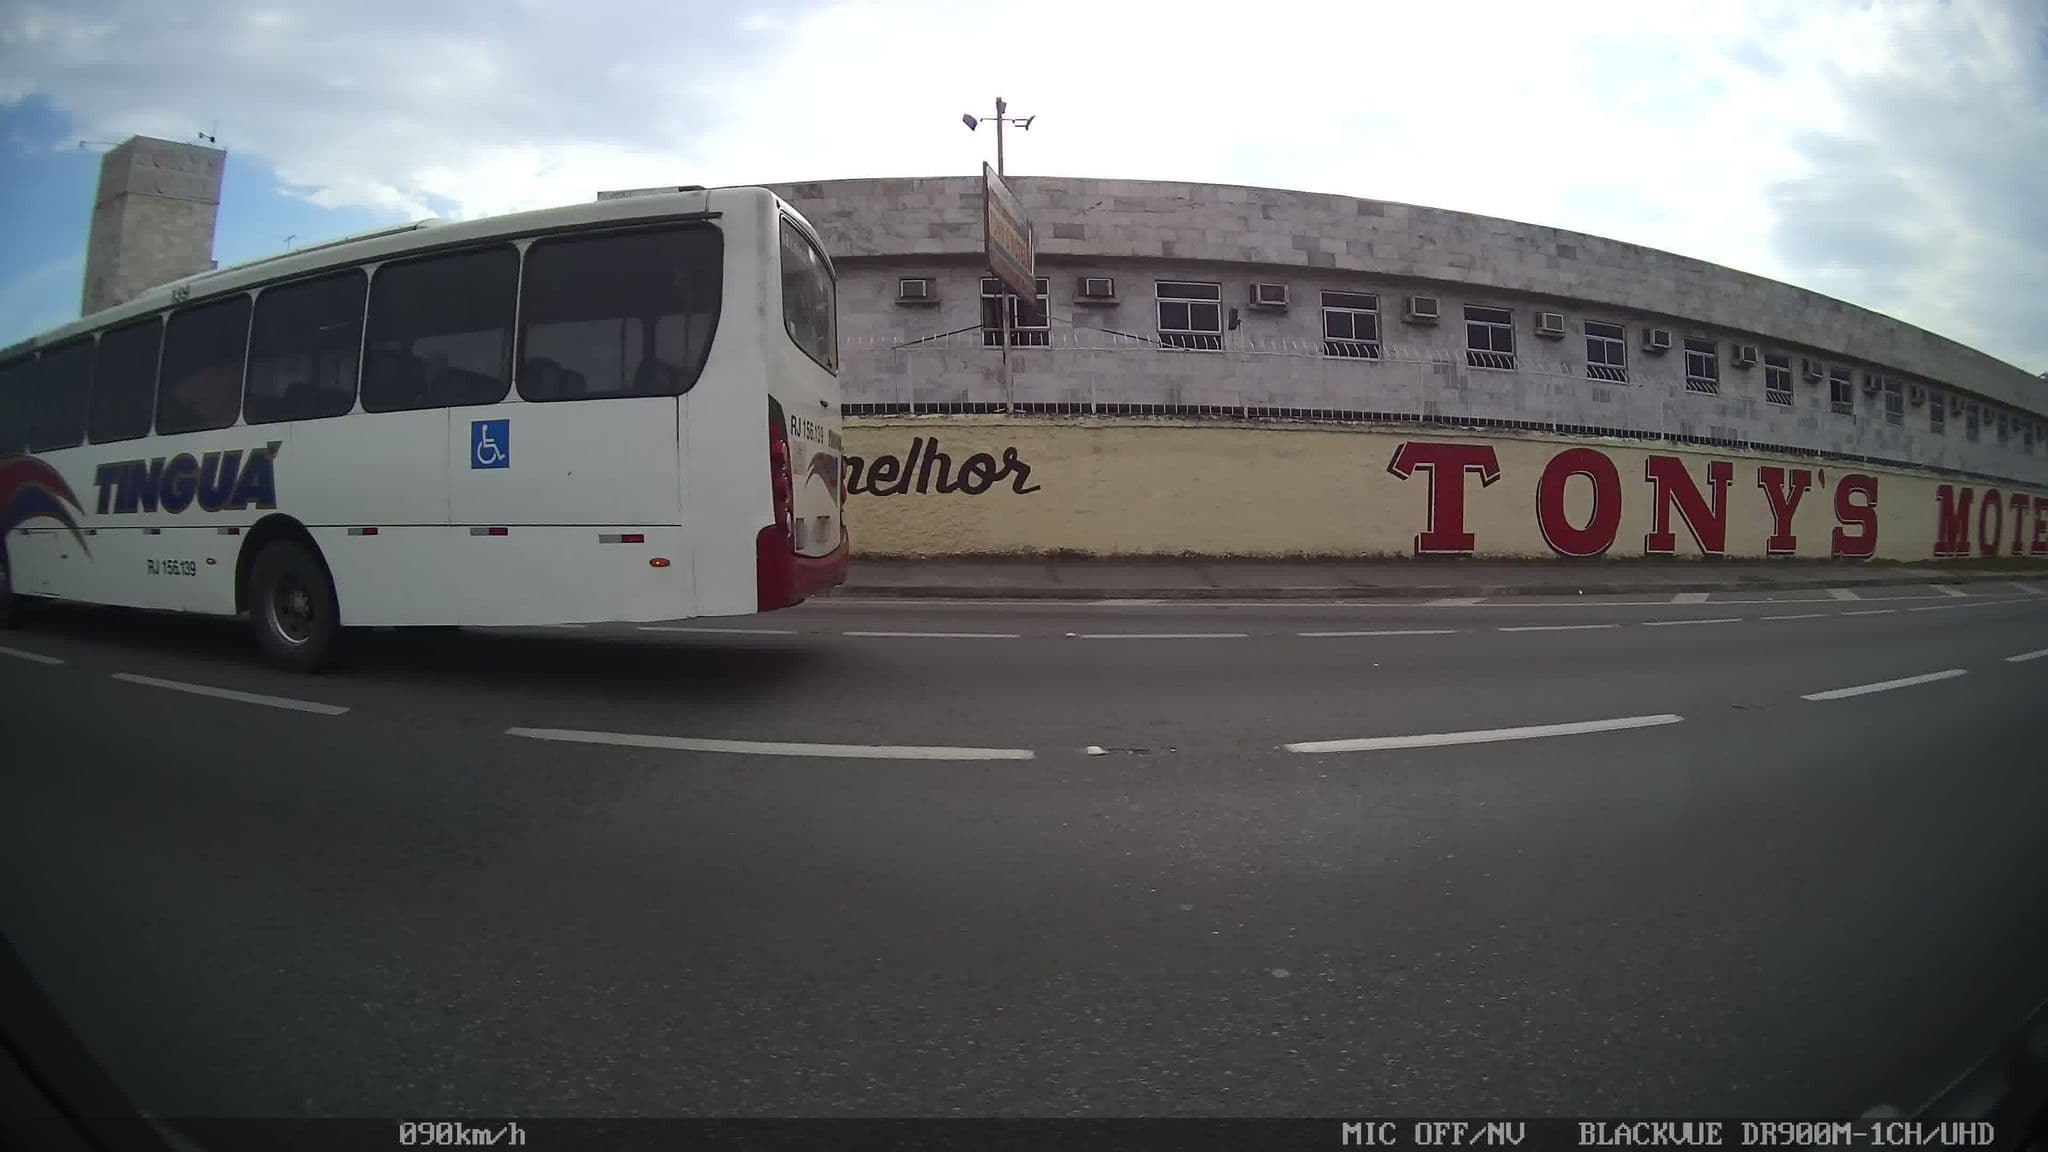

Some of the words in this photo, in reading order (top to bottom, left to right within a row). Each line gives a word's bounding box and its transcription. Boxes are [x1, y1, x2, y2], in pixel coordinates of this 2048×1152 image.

[790, 414, 801, 438] RJ
[94, 440, 283, 515] TINGUÁ
[1386, 441, 1880, 560] TONY'S
[147, 559, 160, 575] RJ
